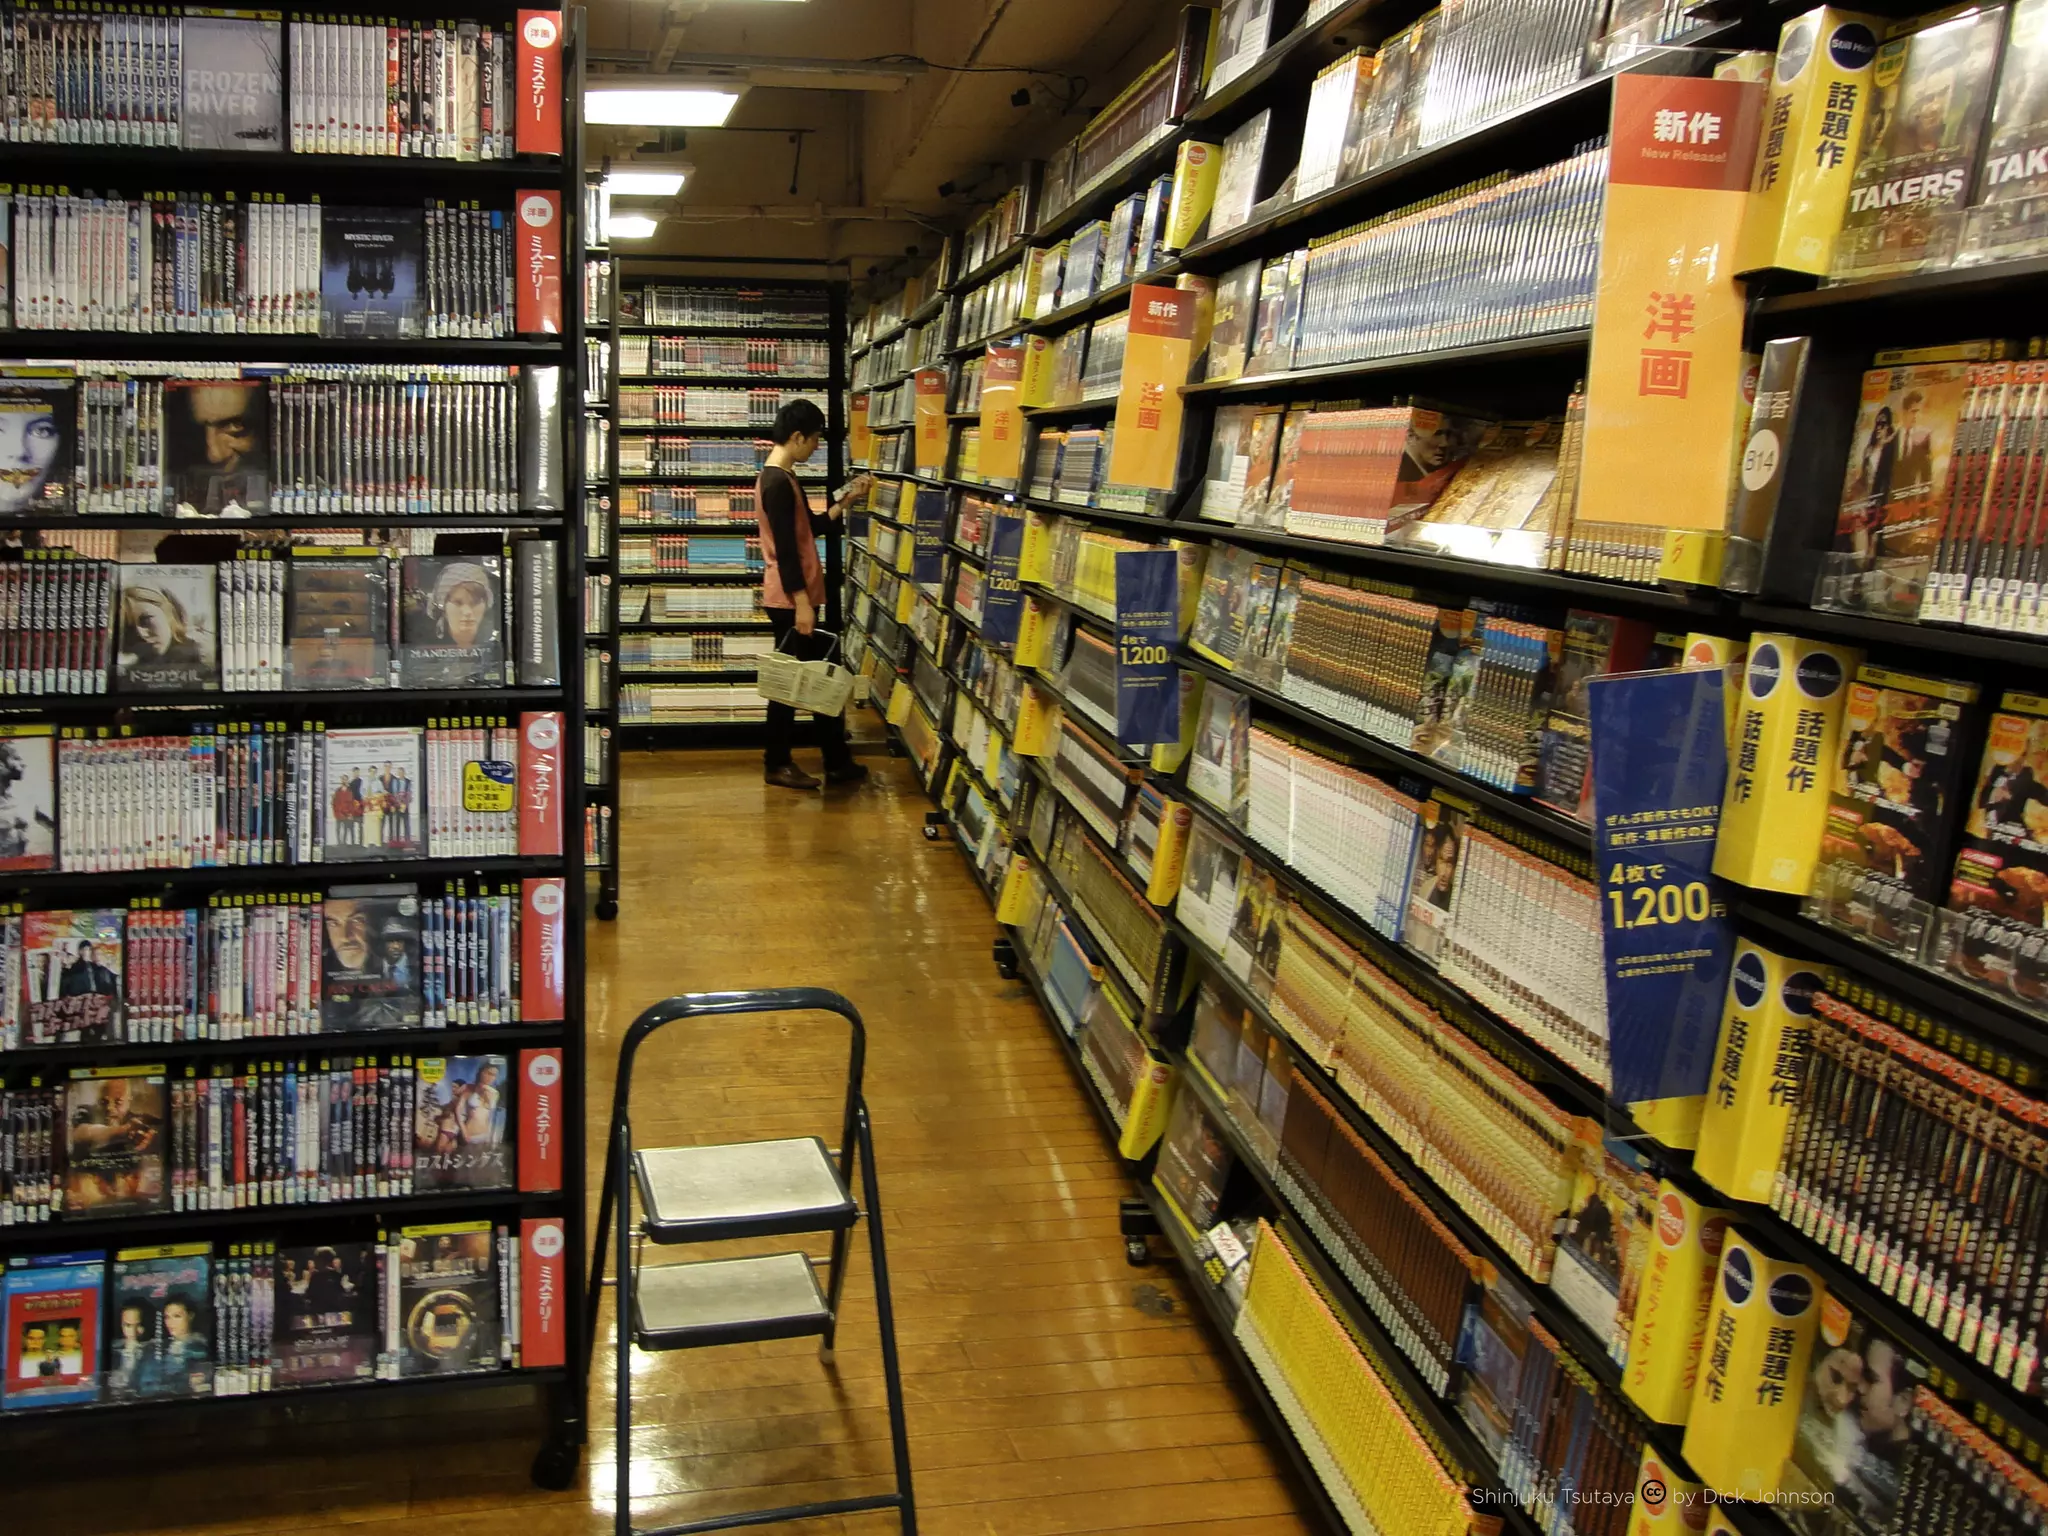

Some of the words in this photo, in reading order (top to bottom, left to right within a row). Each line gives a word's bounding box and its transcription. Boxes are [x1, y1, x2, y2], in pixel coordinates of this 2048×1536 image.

[187, 69, 280, 96] FROZEN
[187, 92, 258, 117] RIVER
[531, 55, 546, 121] ミステリー
[1653, 108, 1721, 145] 新作
[1758, 92, 1794, 194] 話題作
[1815, 81, 1858, 170] 話題作
[1850, 168, 1966, 213] TAKERS
[530, 235, 544, 300] ミステリー
[1147, 300, 1180, 318] 新作
[1638, 291, 1697, 399] 洋画
[992, 409, 1010, 441] 洋画
[1136, 381, 1163, 432] 洋画
[533, 553, 543, 596] TSUTAYA
[410, 648, 488, 660] MANDERLAY
[533, 598, 544, 664] RECOMMEND
[1732, 709, 1765, 805] 話題作
[1785, 708, 1826, 794] 話題作
[1608, 862, 1667, 885] 4枚で
[540, 923, 553, 988] ミステリー
[1715, 1015, 1749, 1110] 話題作
[1767, 1025, 1810, 1108] 話題作
[536, 1094, 552, 1160] ミステリー
[540, 1265, 554, 1333] ミステリー
[1756, 1326, 1797, 1407] 話題作
